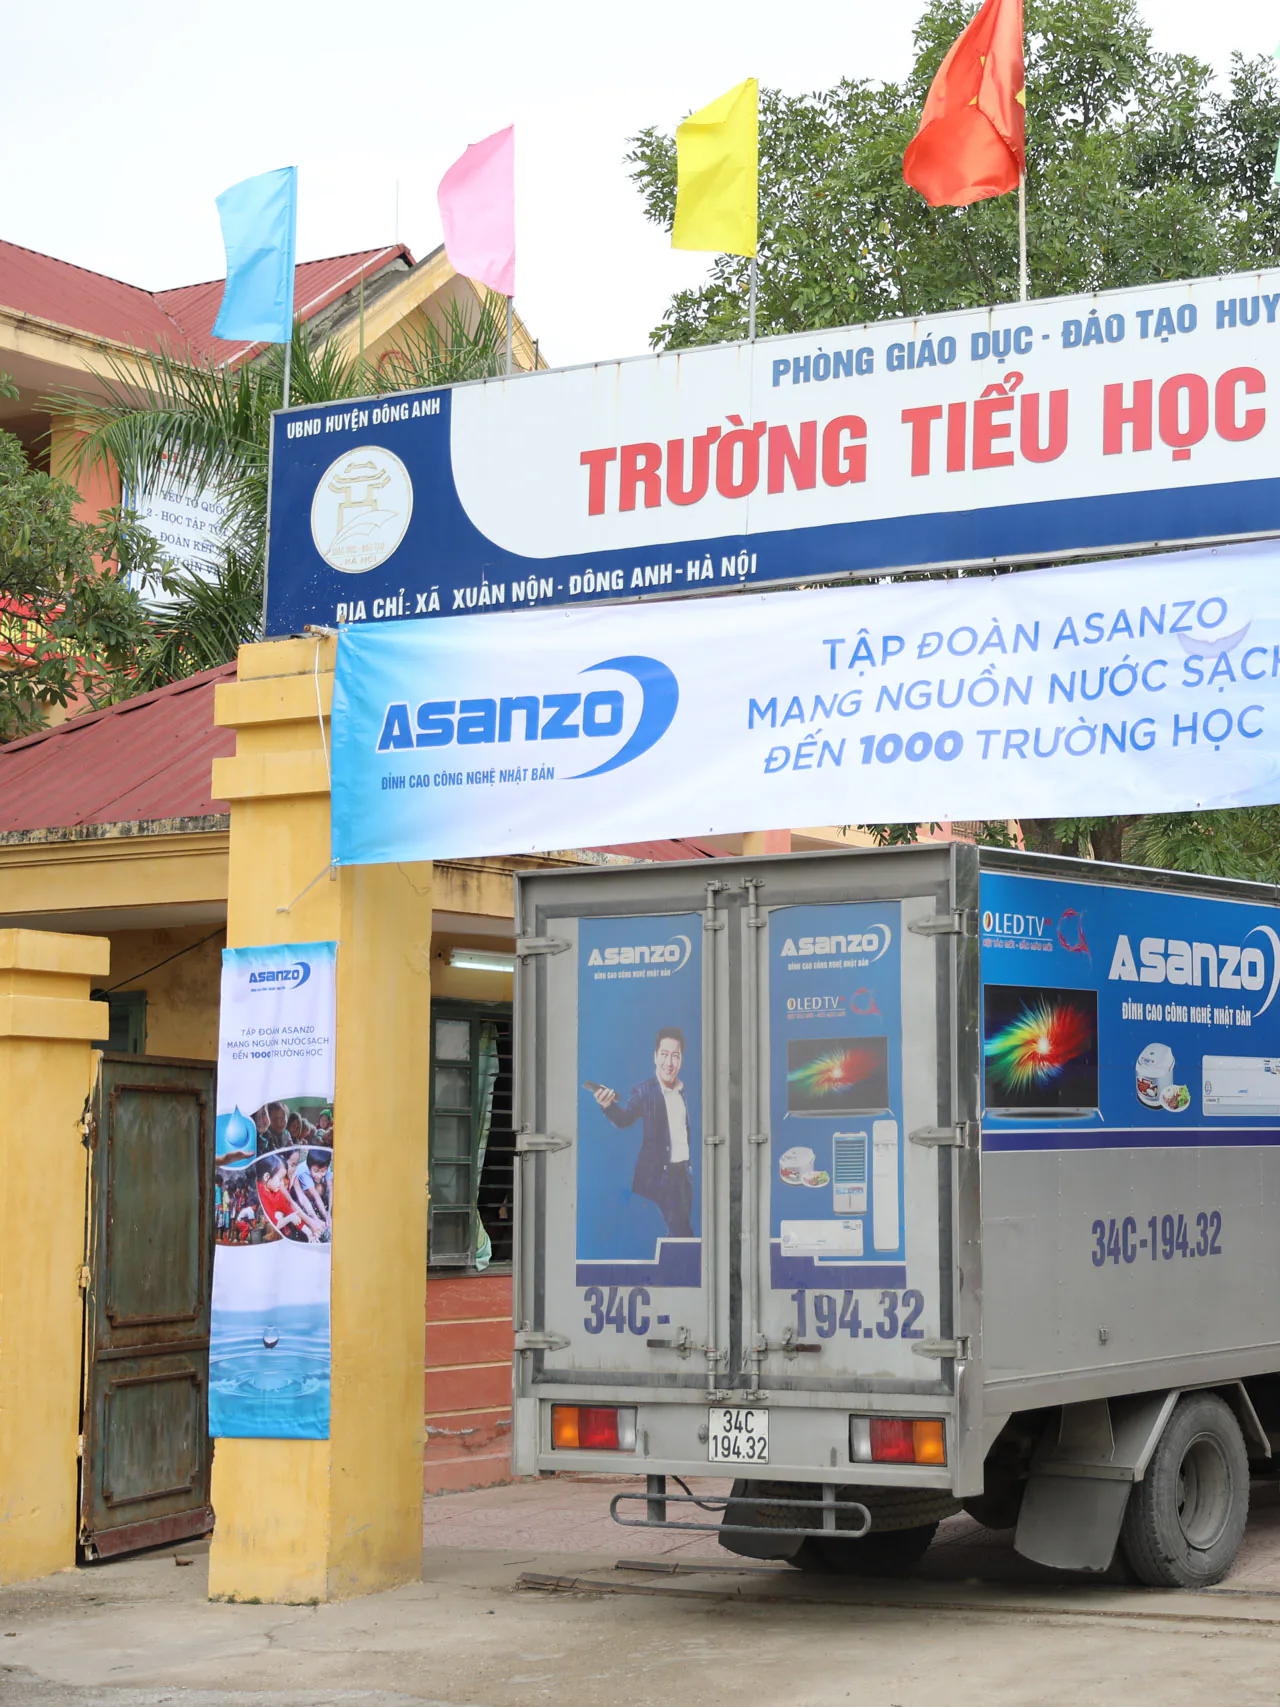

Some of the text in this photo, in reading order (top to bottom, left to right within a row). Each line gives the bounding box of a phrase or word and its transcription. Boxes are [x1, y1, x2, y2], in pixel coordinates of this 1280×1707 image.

[773, 345, 874, 387] PHÒNG
[887, 332, 956, 372] GIÁO
[971, 325, 1033, 364] DỤC
[1136, 303, 1197, 343] TẠO
[287, 398, 440, 439] UBND HUYỆN ĐÔNG ANH
[580, 413, 867, 518] TRƯỜNG
[902, 371, 1068, 477] TIỂU
[1103, 367, 1266, 461] HỌC
[160, 532, 190, 548] ĐOÀN
[161, 511, 183, 525] HỌC
[186, 517, 205, 531] TẬP
[415, 586, 440, 614] XÃ
[452, 581, 505, 610] XUÂN
[512, 575, 554, 606] NỘN
[569, 568, 624, 596] ĐÔNG
[687, 554, 714, 582] HÀ
[721, 549, 757, 581] NỘI
[822, 597, 1228, 676] TẬP ĐOÀN ASANZO
[748, 689, 863, 729] MANG
[875, 663, 1033, 713] NGUỒN
[1048, 654, 1168, 704] NƯỚC
[764, 704, 1265, 774] ĐẾN 1000 TRƯỜNG HỌC
[381, 763, 555, 790] ĐỈNH CAO CÔNG NGHỆ NHẬT BẢN
[281, 1026, 315, 1034] ASANZO
[1122, 997, 1252, 1028] ĐỈNH CAO CÔNG NGHỆ NHẬT BẢN
[227, 1040, 250, 1048] MANG
[1092, 1210, 1222, 1267] 34C-194.32
[791, 1289, 925, 1339] 194.32
[723, 1410, 754, 1434] 34C
[712, 1435, 767, 1460] 194.32
